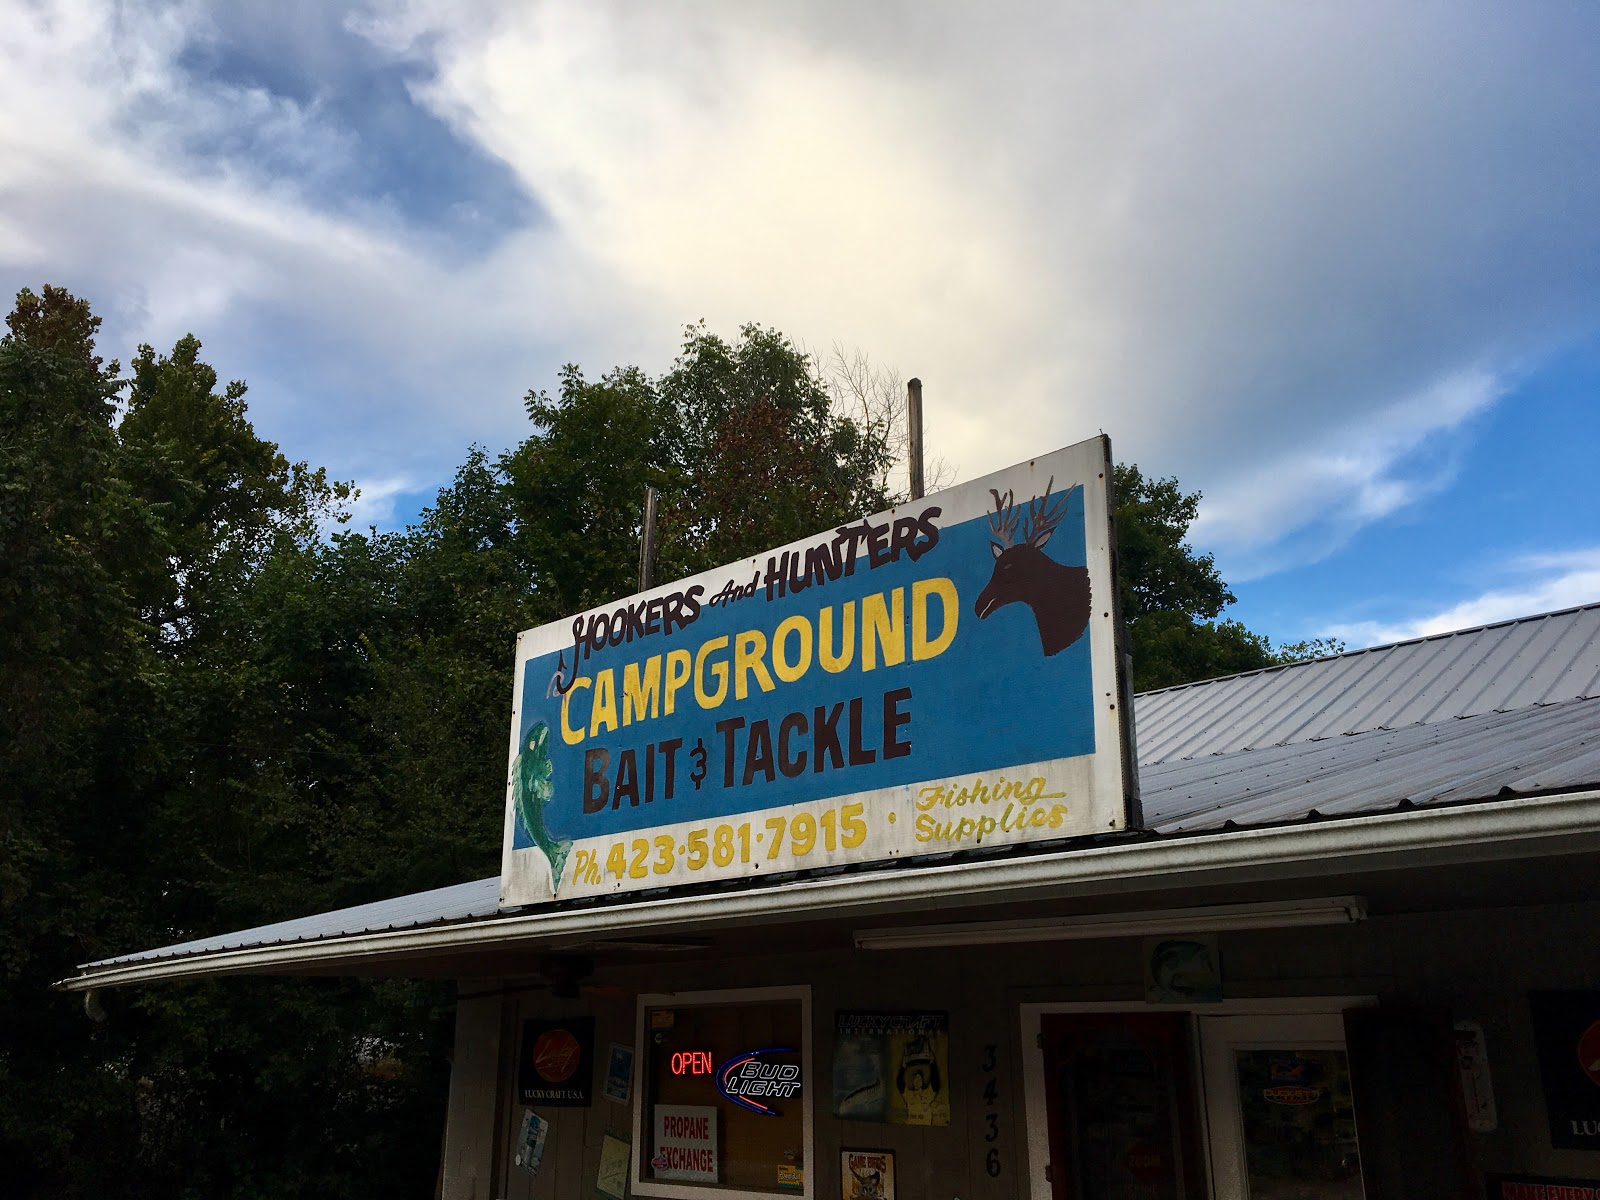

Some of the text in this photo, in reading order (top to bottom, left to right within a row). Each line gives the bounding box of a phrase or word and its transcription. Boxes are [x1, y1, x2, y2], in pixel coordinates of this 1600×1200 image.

[558, 585, 704, 694] HOOKERS
[709, 571, 760, 607] And
[561, 577, 959, 745] CAMPGROUND
[583, 737, 683, 814] BAIT
[716, 687, 912, 788] TACKLE
[916, 777, 1067, 811] Fishing
[915, 803, 1068, 844] Supplies
[671, 1052, 712, 1075] OPEN
[740, 1061, 800, 1080] BUD
[726, 1077, 802, 1097] LIGHT
[664, 1116, 709, 1140] PROPANE
[1571, 1120, 1600, 1136] LU
